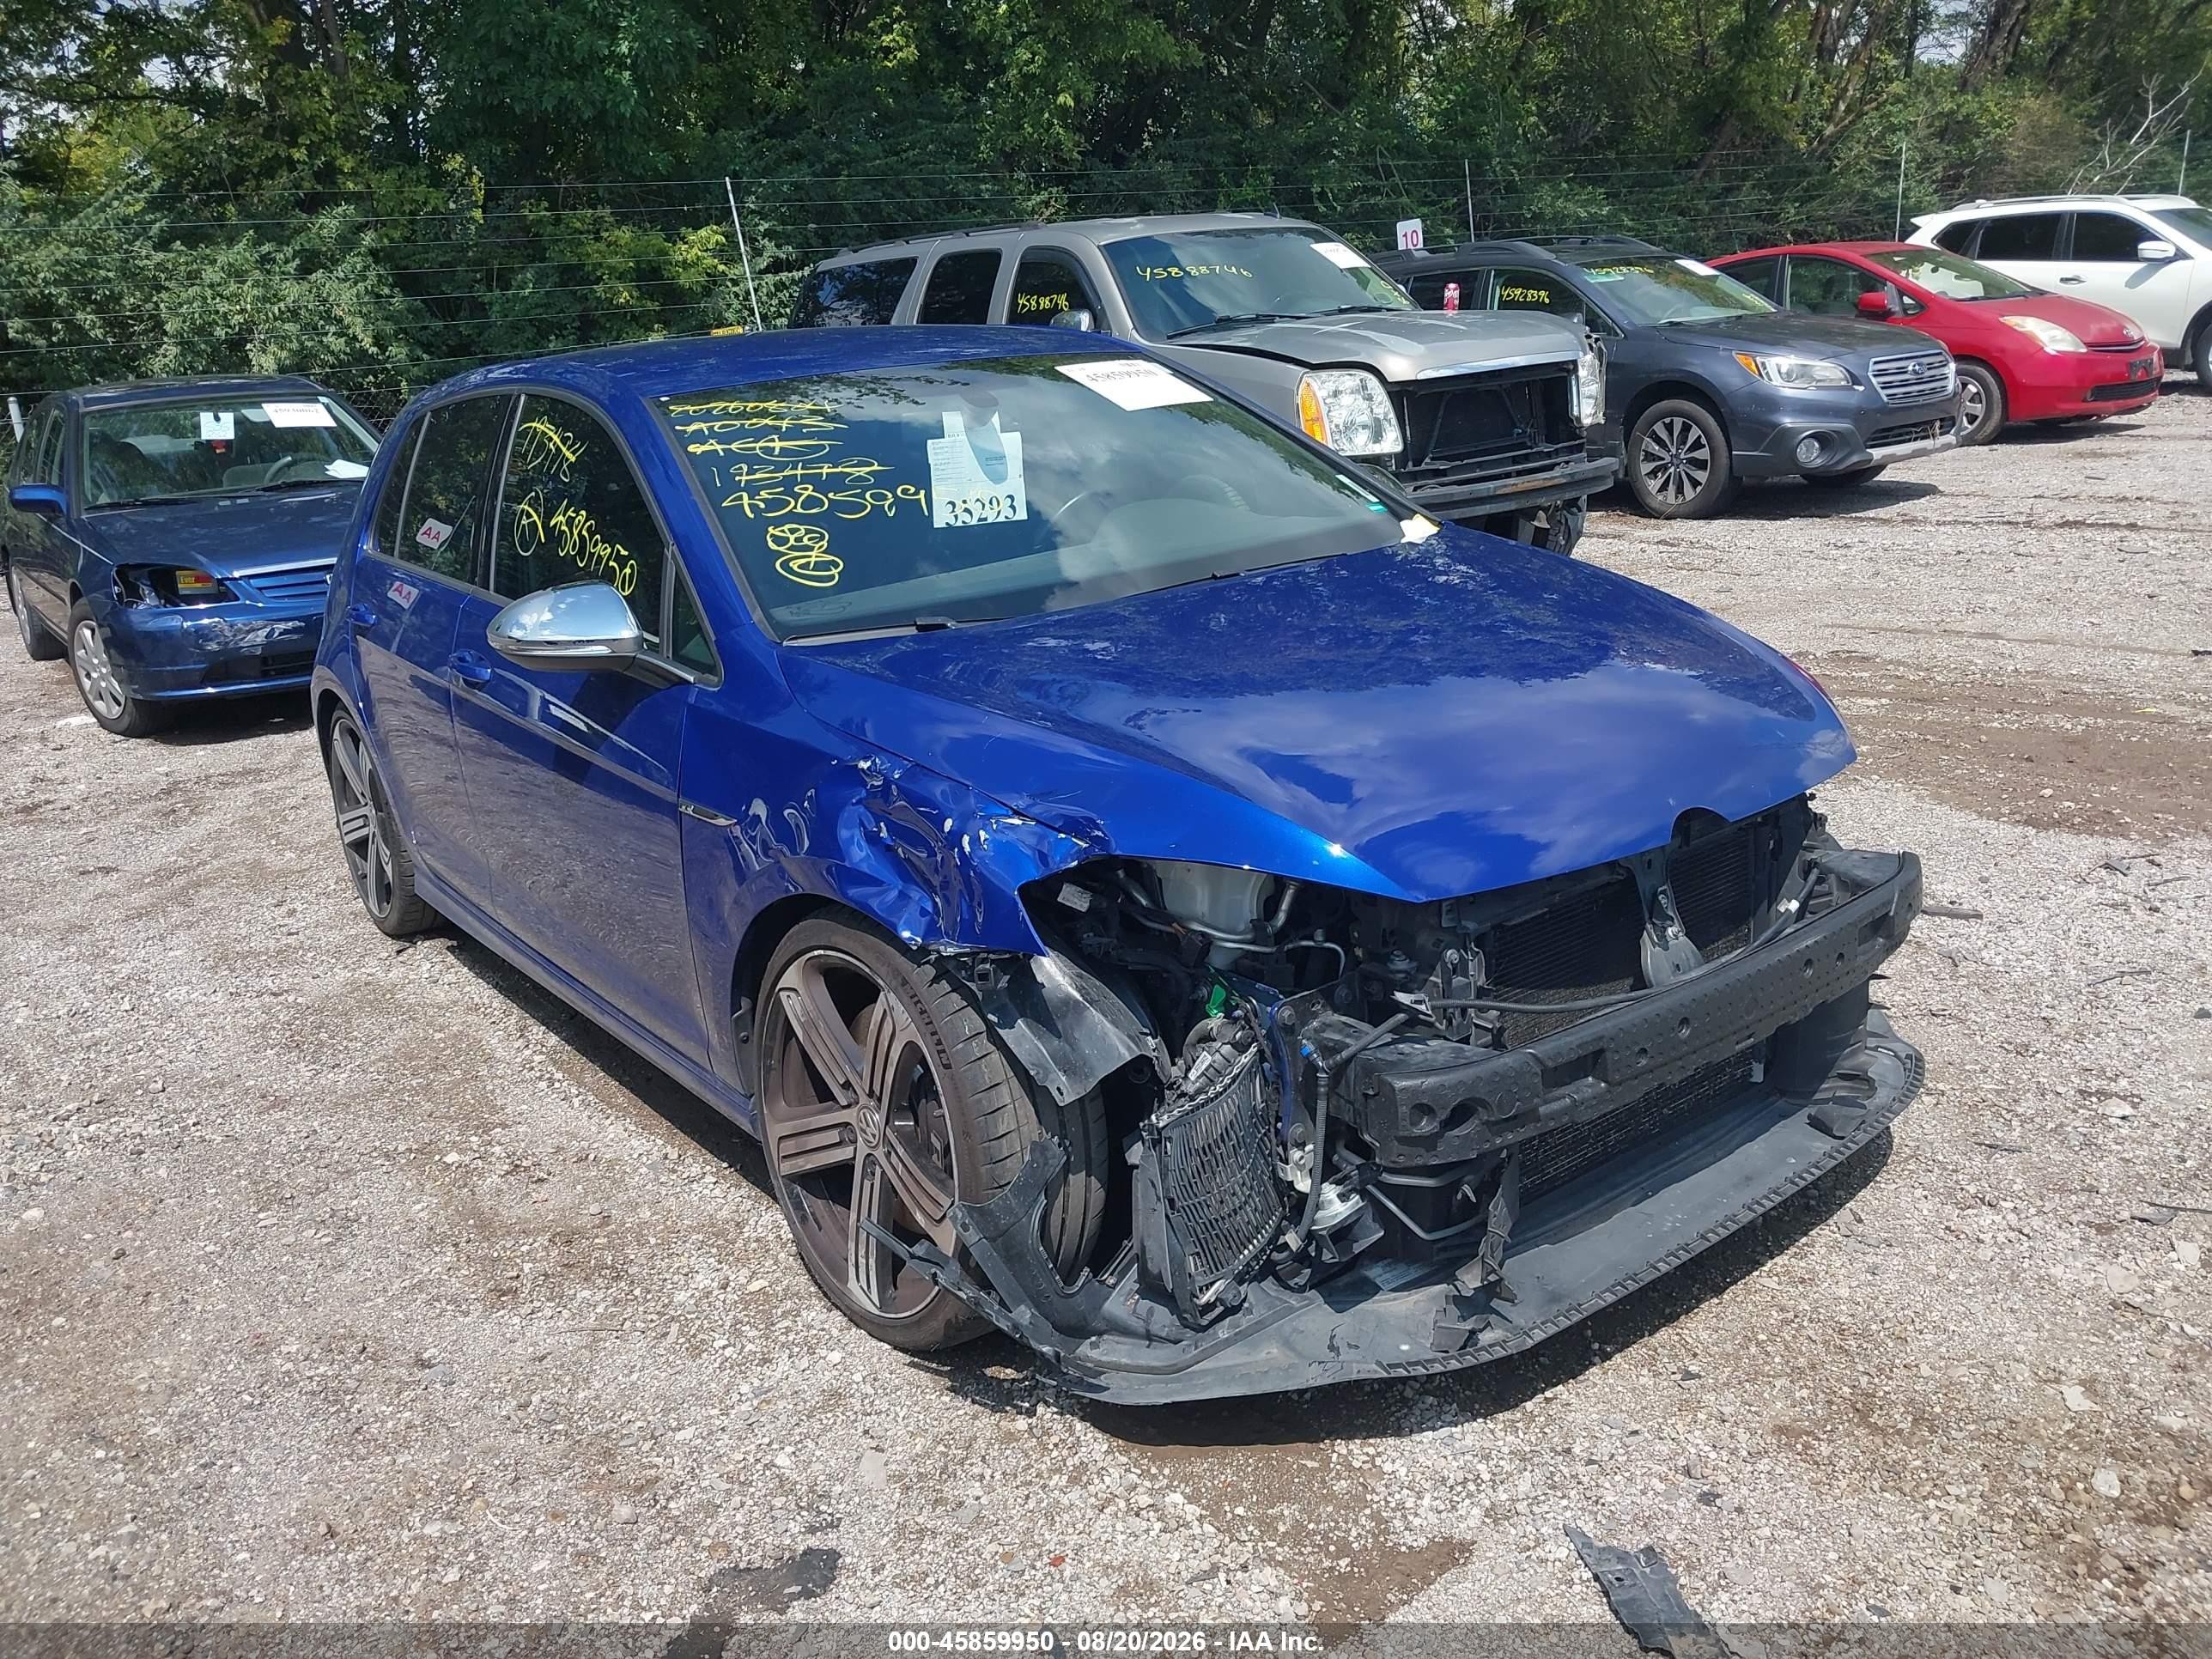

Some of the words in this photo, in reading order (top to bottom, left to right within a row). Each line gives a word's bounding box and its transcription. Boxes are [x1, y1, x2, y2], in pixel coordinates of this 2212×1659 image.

[1402, 229, 1419, 249] 10
[1136, 264, 1253, 282] 45888746
[1017, 292, 1070, 314] 45888746
[1501, 285, 1550, 304] 45928396
[945, 494, 1017, 527] 35293
[421, 526, 441, 543] AA
[392, 584, 412, 604] AA
